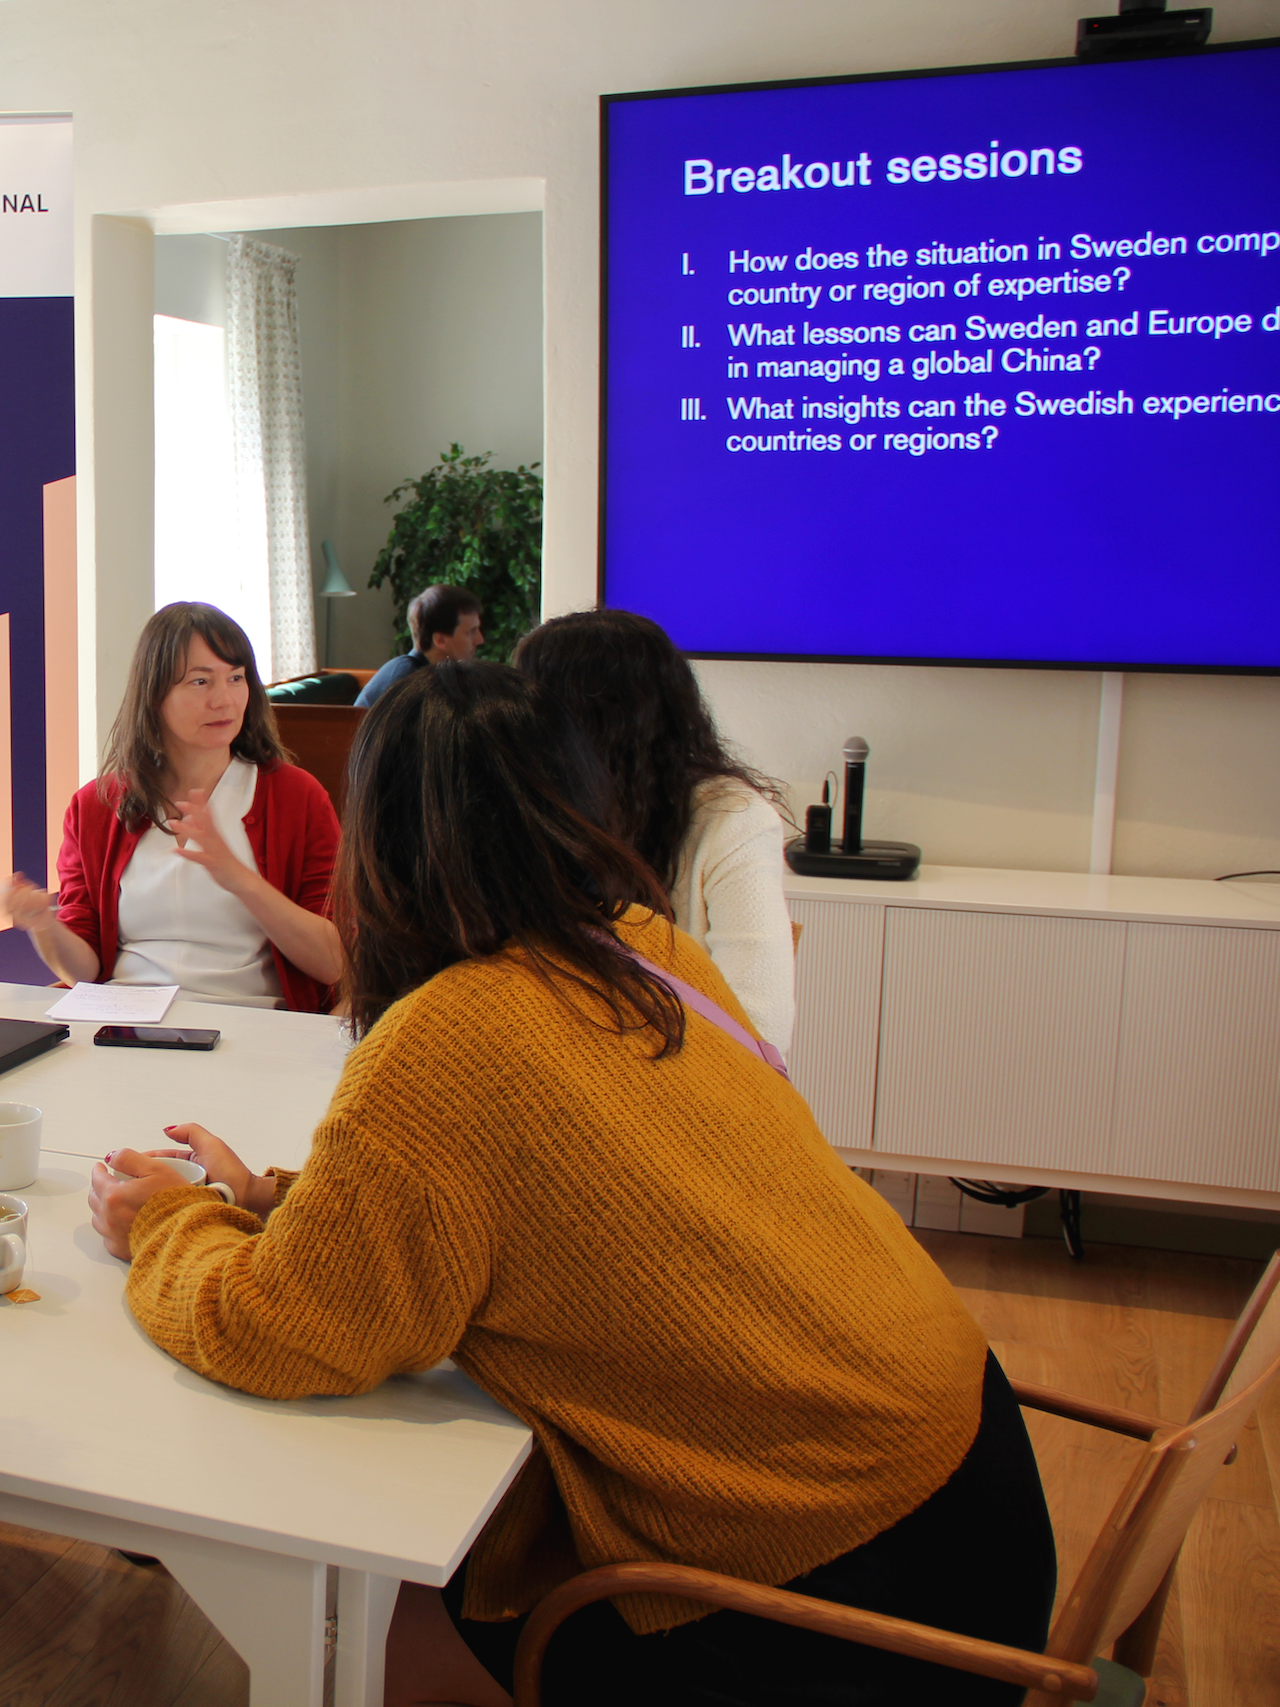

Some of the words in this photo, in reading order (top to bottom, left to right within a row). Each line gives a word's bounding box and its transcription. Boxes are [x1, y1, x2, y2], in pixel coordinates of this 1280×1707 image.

[684, 152, 872, 196] Breakout
[885, 140, 1083, 185] sessions
[682, 252, 695, 276] I.
[729, 249, 788, 274] How
[794, 246, 859, 272] does
[865, 243, 908, 269] the
[915, 238, 1028, 267] situation
[1037, 236, 1061, 261] in
[1069, 230, 1187, 260] Sweden
[1196, 231, 1280, 257] comp
[727, 282, 822, 310] country
[828, 284, 857, 302] or
[863, 274, 945, 306] region
[953, 272, 982, 298] of
[987, 266, 1131, 302] expertise?
[681, 325, 701, 349] II.
[726, 321, 796, 347] What
[802, 321, 901, 346] lessons
[908, 323, 957, 343] can
[964, 313, 1077, 341] Sweden
[1085, 310, 1139, 338] and
[1148, 309, 1253, 340] Europe
[727, 355, 749, 379] in
[756, 352, 881, 383] managing
[887, 357, 905, 376] a
[911, 348, 993, 381] global
[1000, 346, 1101, 373] China?
[680, 397, 707, 421] III.
[726, 396, 795, 420] What
[801, 394, 901, 425] insights
[907, 399, 956, 418] can
[963, 392, 1007, 418] the
[1014, 389, 1134, 417] Swedish
[725, 427, 842, 453] countries
[848, 433, 877, 451] or
[883, 425, 999, 457] regions?
